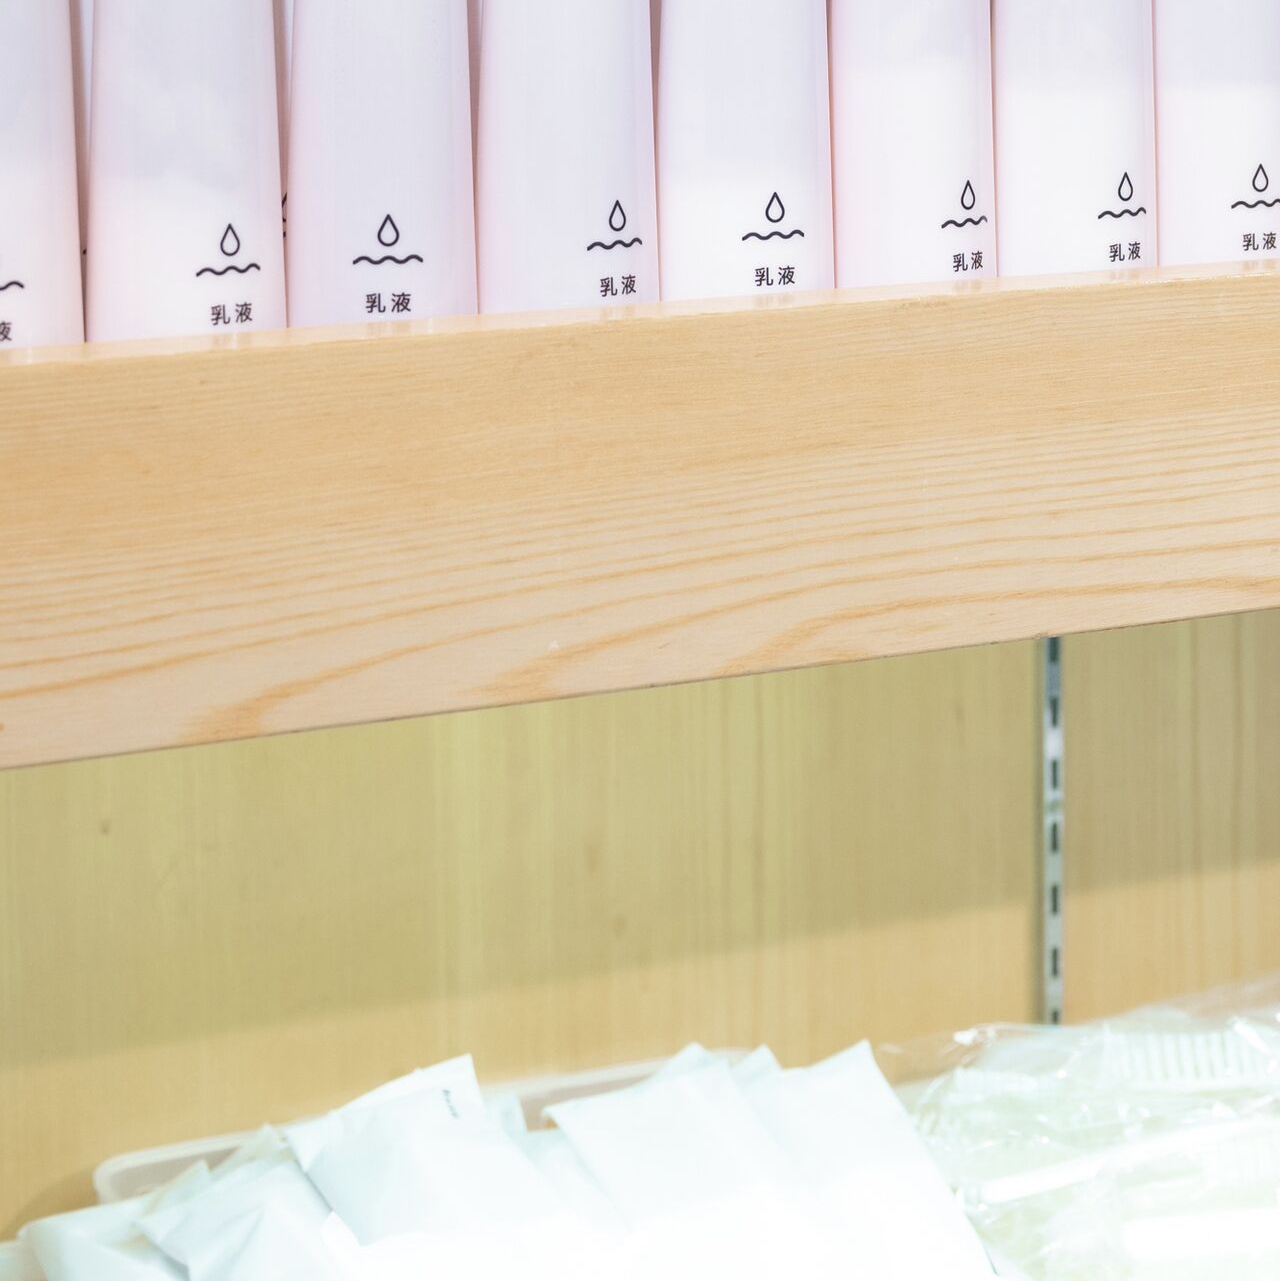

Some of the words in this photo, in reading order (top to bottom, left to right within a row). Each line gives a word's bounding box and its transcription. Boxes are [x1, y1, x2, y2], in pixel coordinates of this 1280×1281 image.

[1108, 241, 1142, 264] 乳液
[1242, 231, 1278, 252] 乳液
[952, 250, 985, 273] 乳液
[599, 274, 637, 298] 乳液
[754, 265, 797, 288] 乳液
[210, 301, 254, 327] 乳液
[365, 291, 412, 315] 乳液
